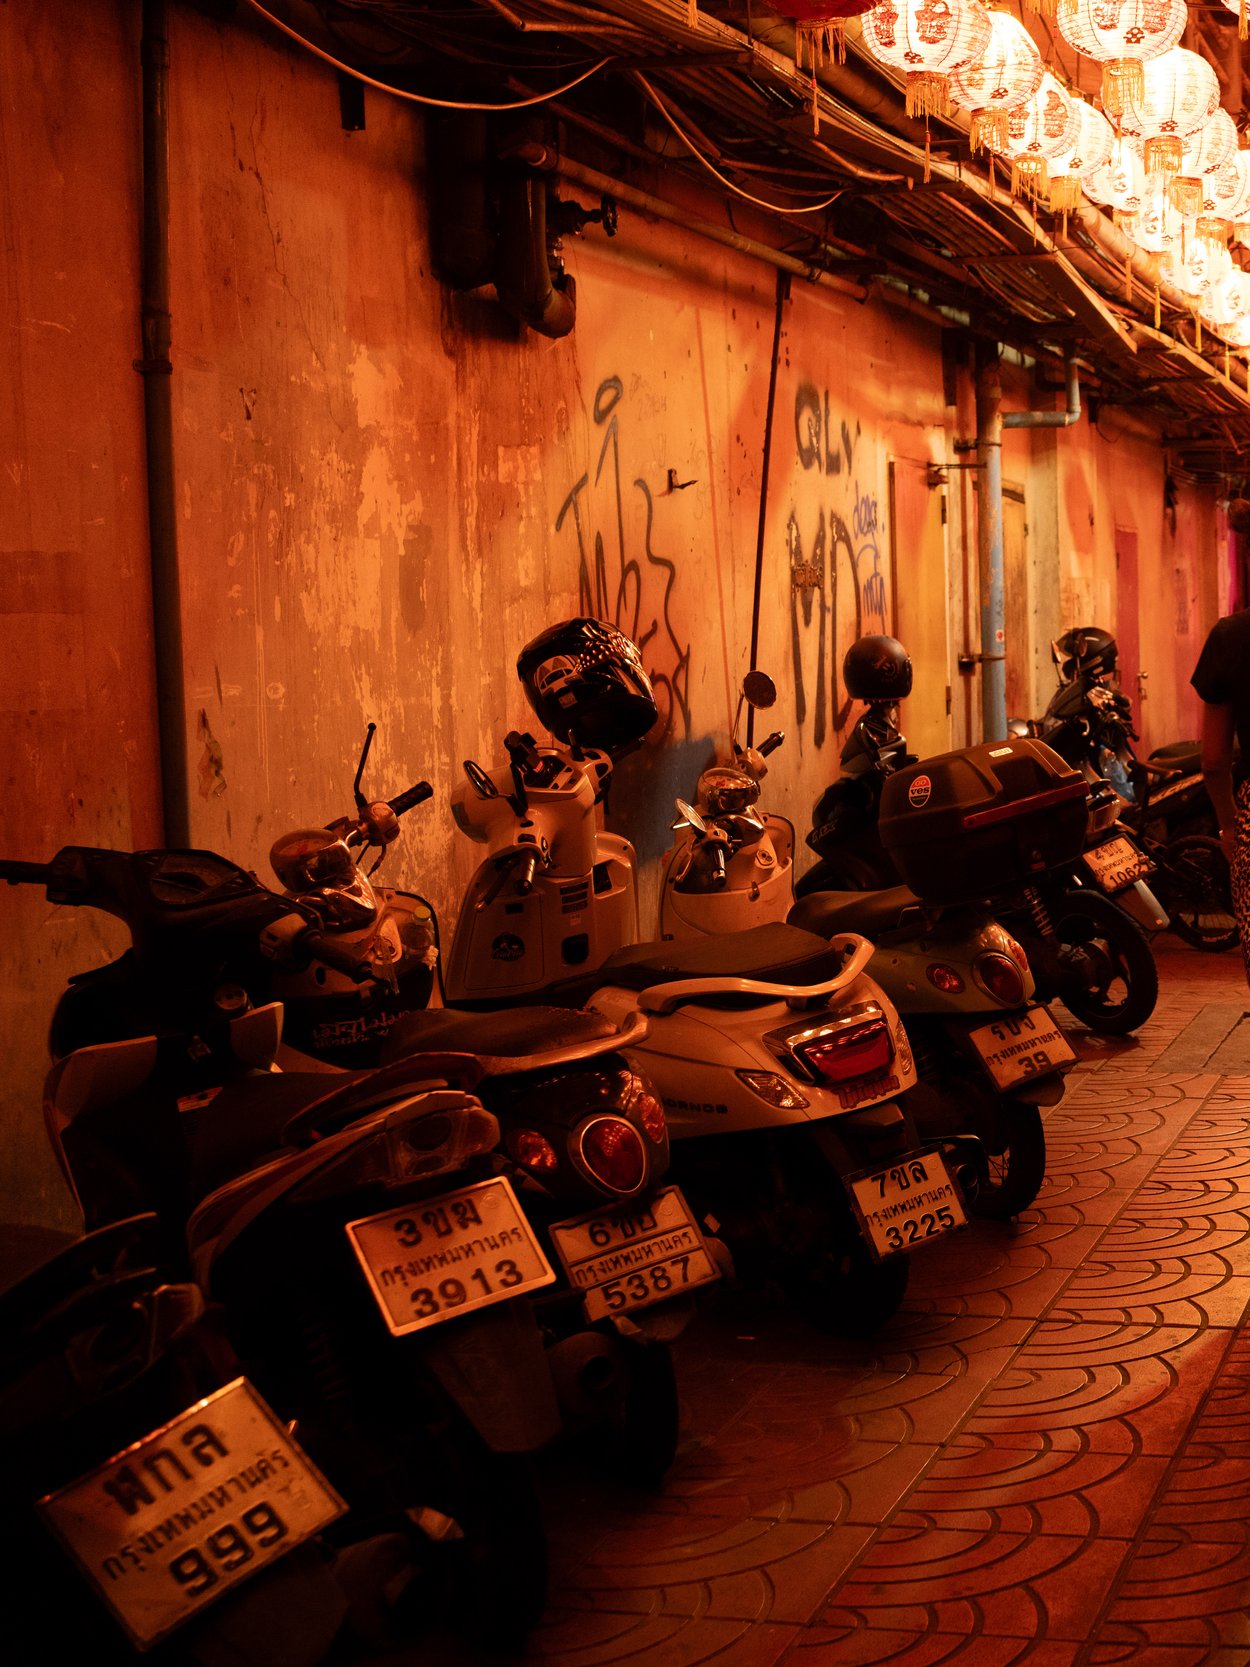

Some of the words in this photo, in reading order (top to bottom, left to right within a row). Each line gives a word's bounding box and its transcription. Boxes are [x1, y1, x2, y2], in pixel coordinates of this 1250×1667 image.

[986, 1030, 1062, 1067] กรุงเทพมหานคร
[1018, 1050, 1052, 1075] 39
[864, 1184, 953, 1227] กรุงเทพมหานคร
[870, 1160, 929, 1198] 7ขล
[885, 1205, 956, 1249] 3225
[380, 1228, 523, 1288] กรุงเทพมหานคร
[574, 1230, 693, 1287] กรุงเทพมหานคร
[601, 1256, 691, 1311] 5387
[410, 1259, 524, 1319] 3913
[101, 1449, 290, 1581] กรุงเทพมหานคร
[168, 1501, 289, 1598] 999
